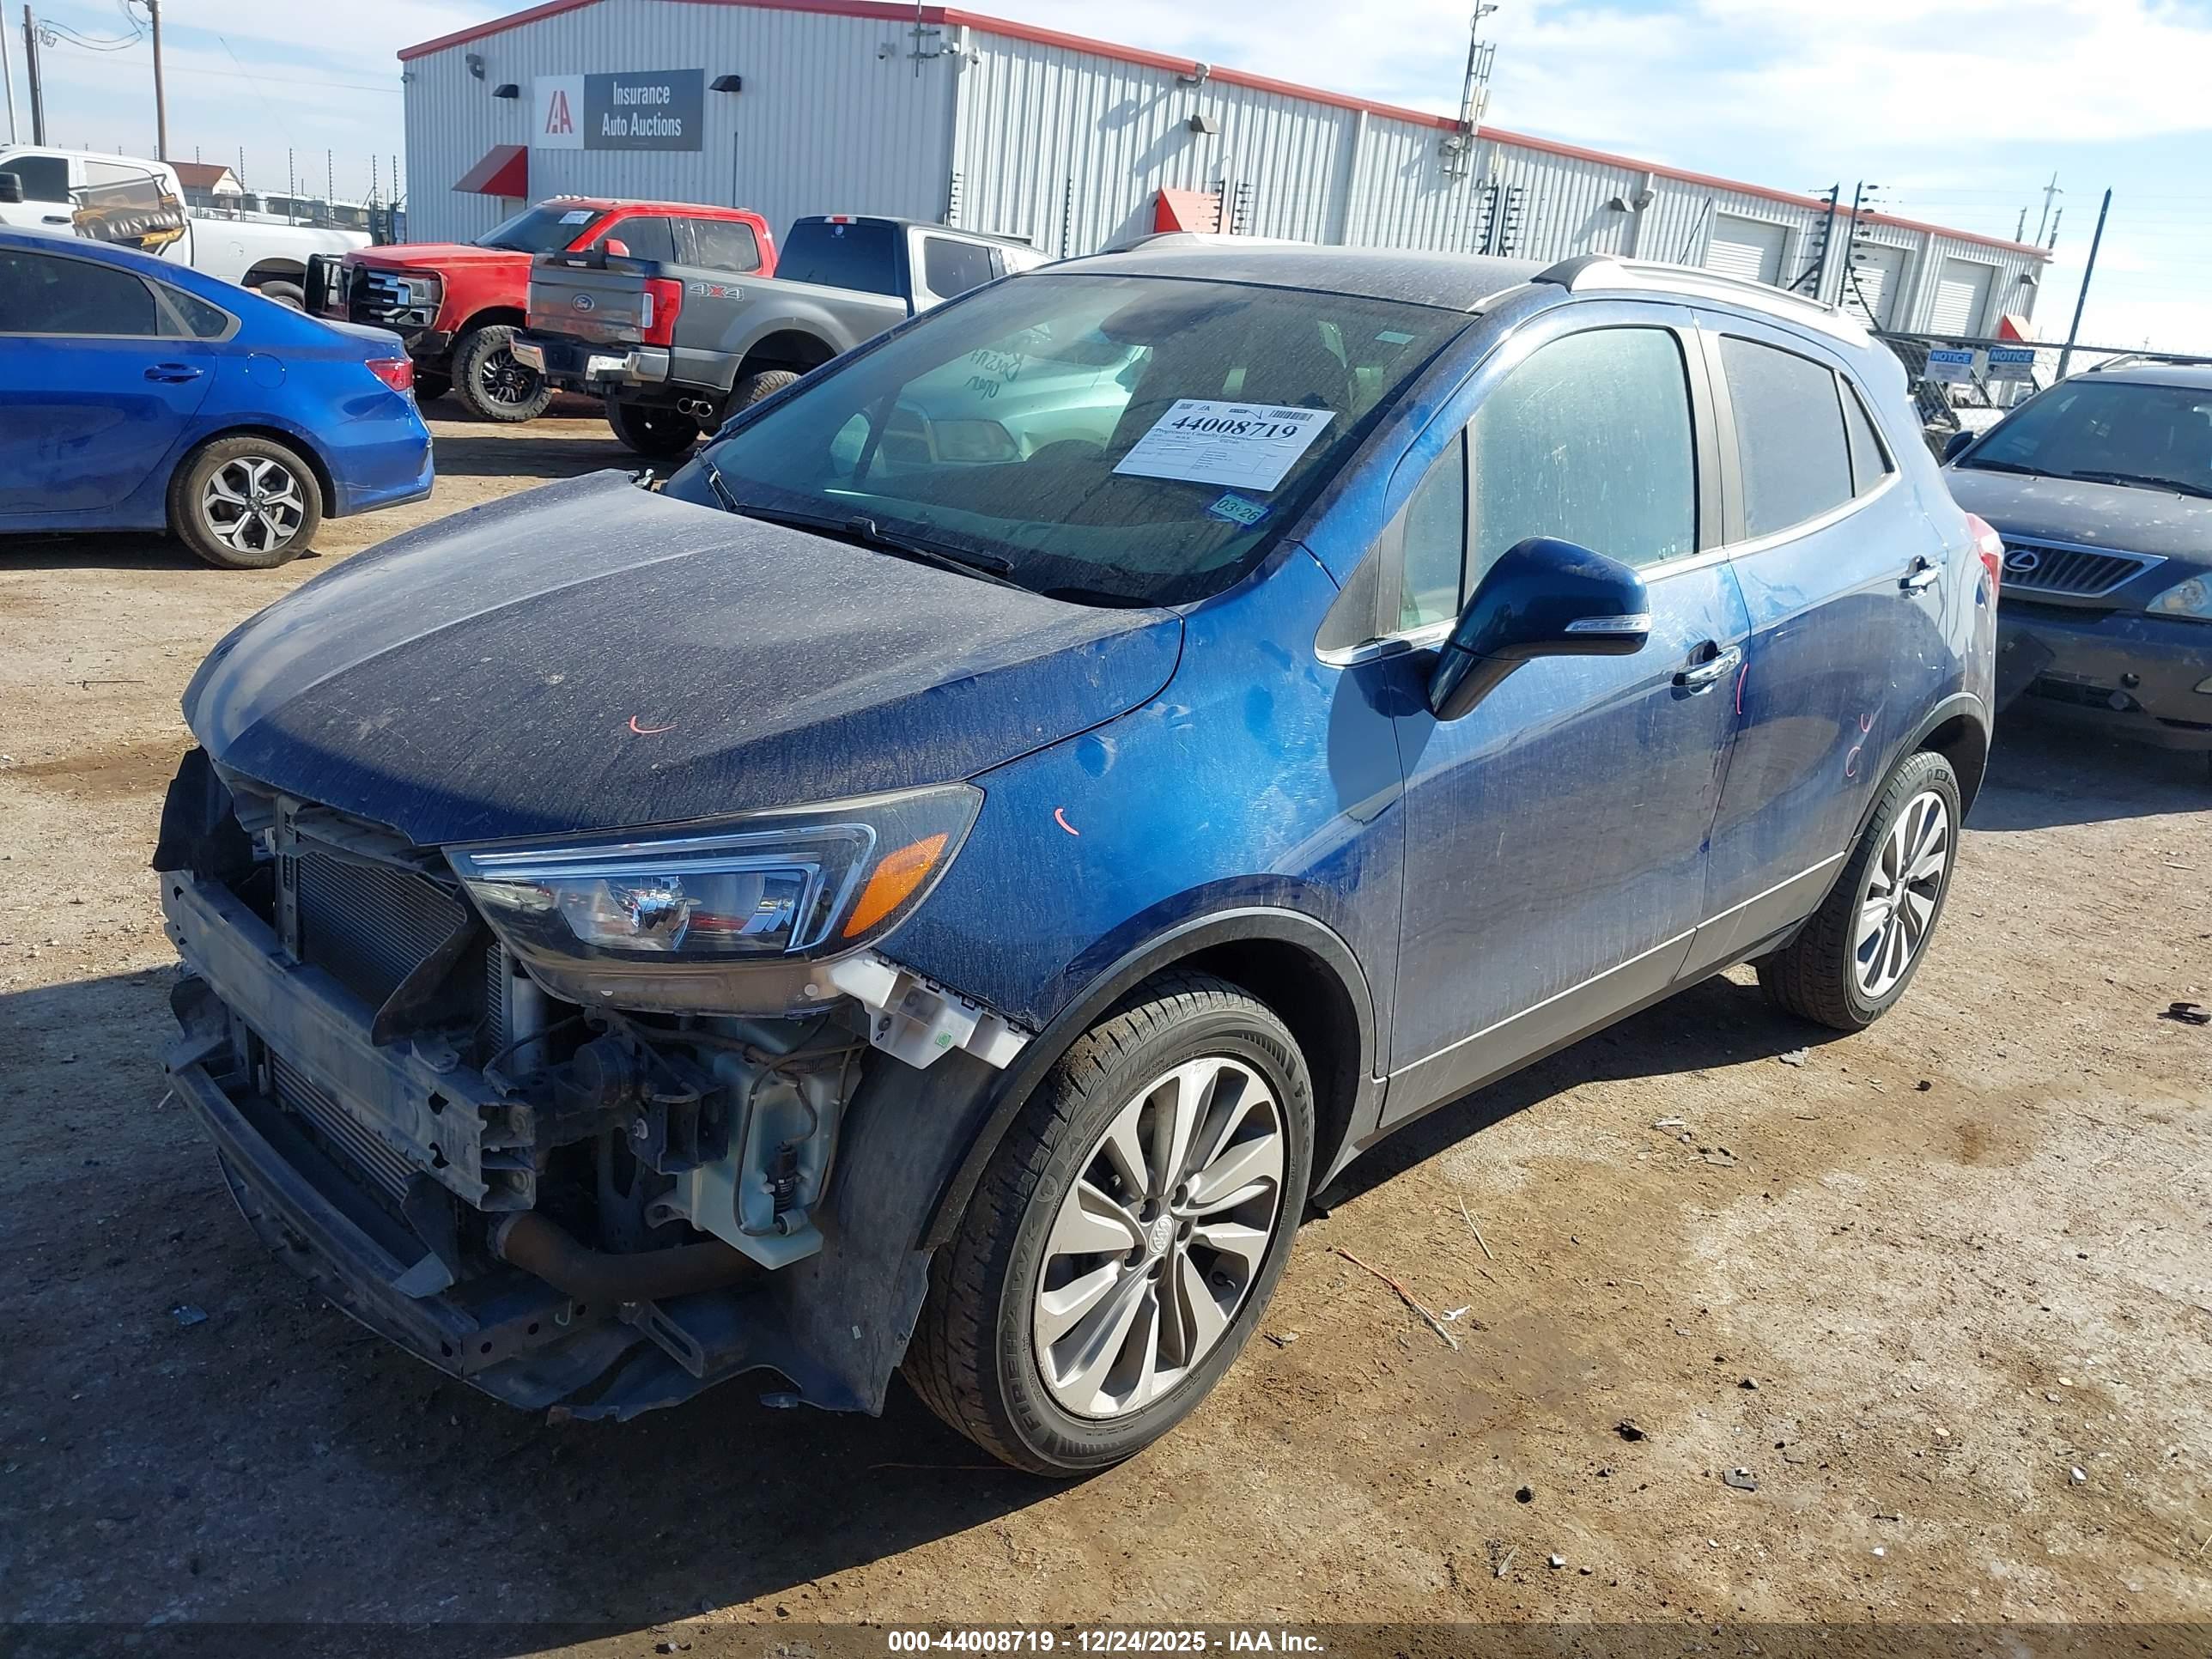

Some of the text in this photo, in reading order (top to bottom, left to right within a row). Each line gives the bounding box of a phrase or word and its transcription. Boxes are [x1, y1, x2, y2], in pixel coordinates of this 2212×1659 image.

[612, 82, 671, 106] Insurance
[602, 112, 682, 137] Auto Auctions
[107, 211, 180, 236] KUSTOM
[1931, 351, 1971, 363] NOTICE
[1990, 350, 2033, 362] NOTICE
[1171, 416, 1298, 439] 44008719
[1217, 500, 1258, 520] 03 26
